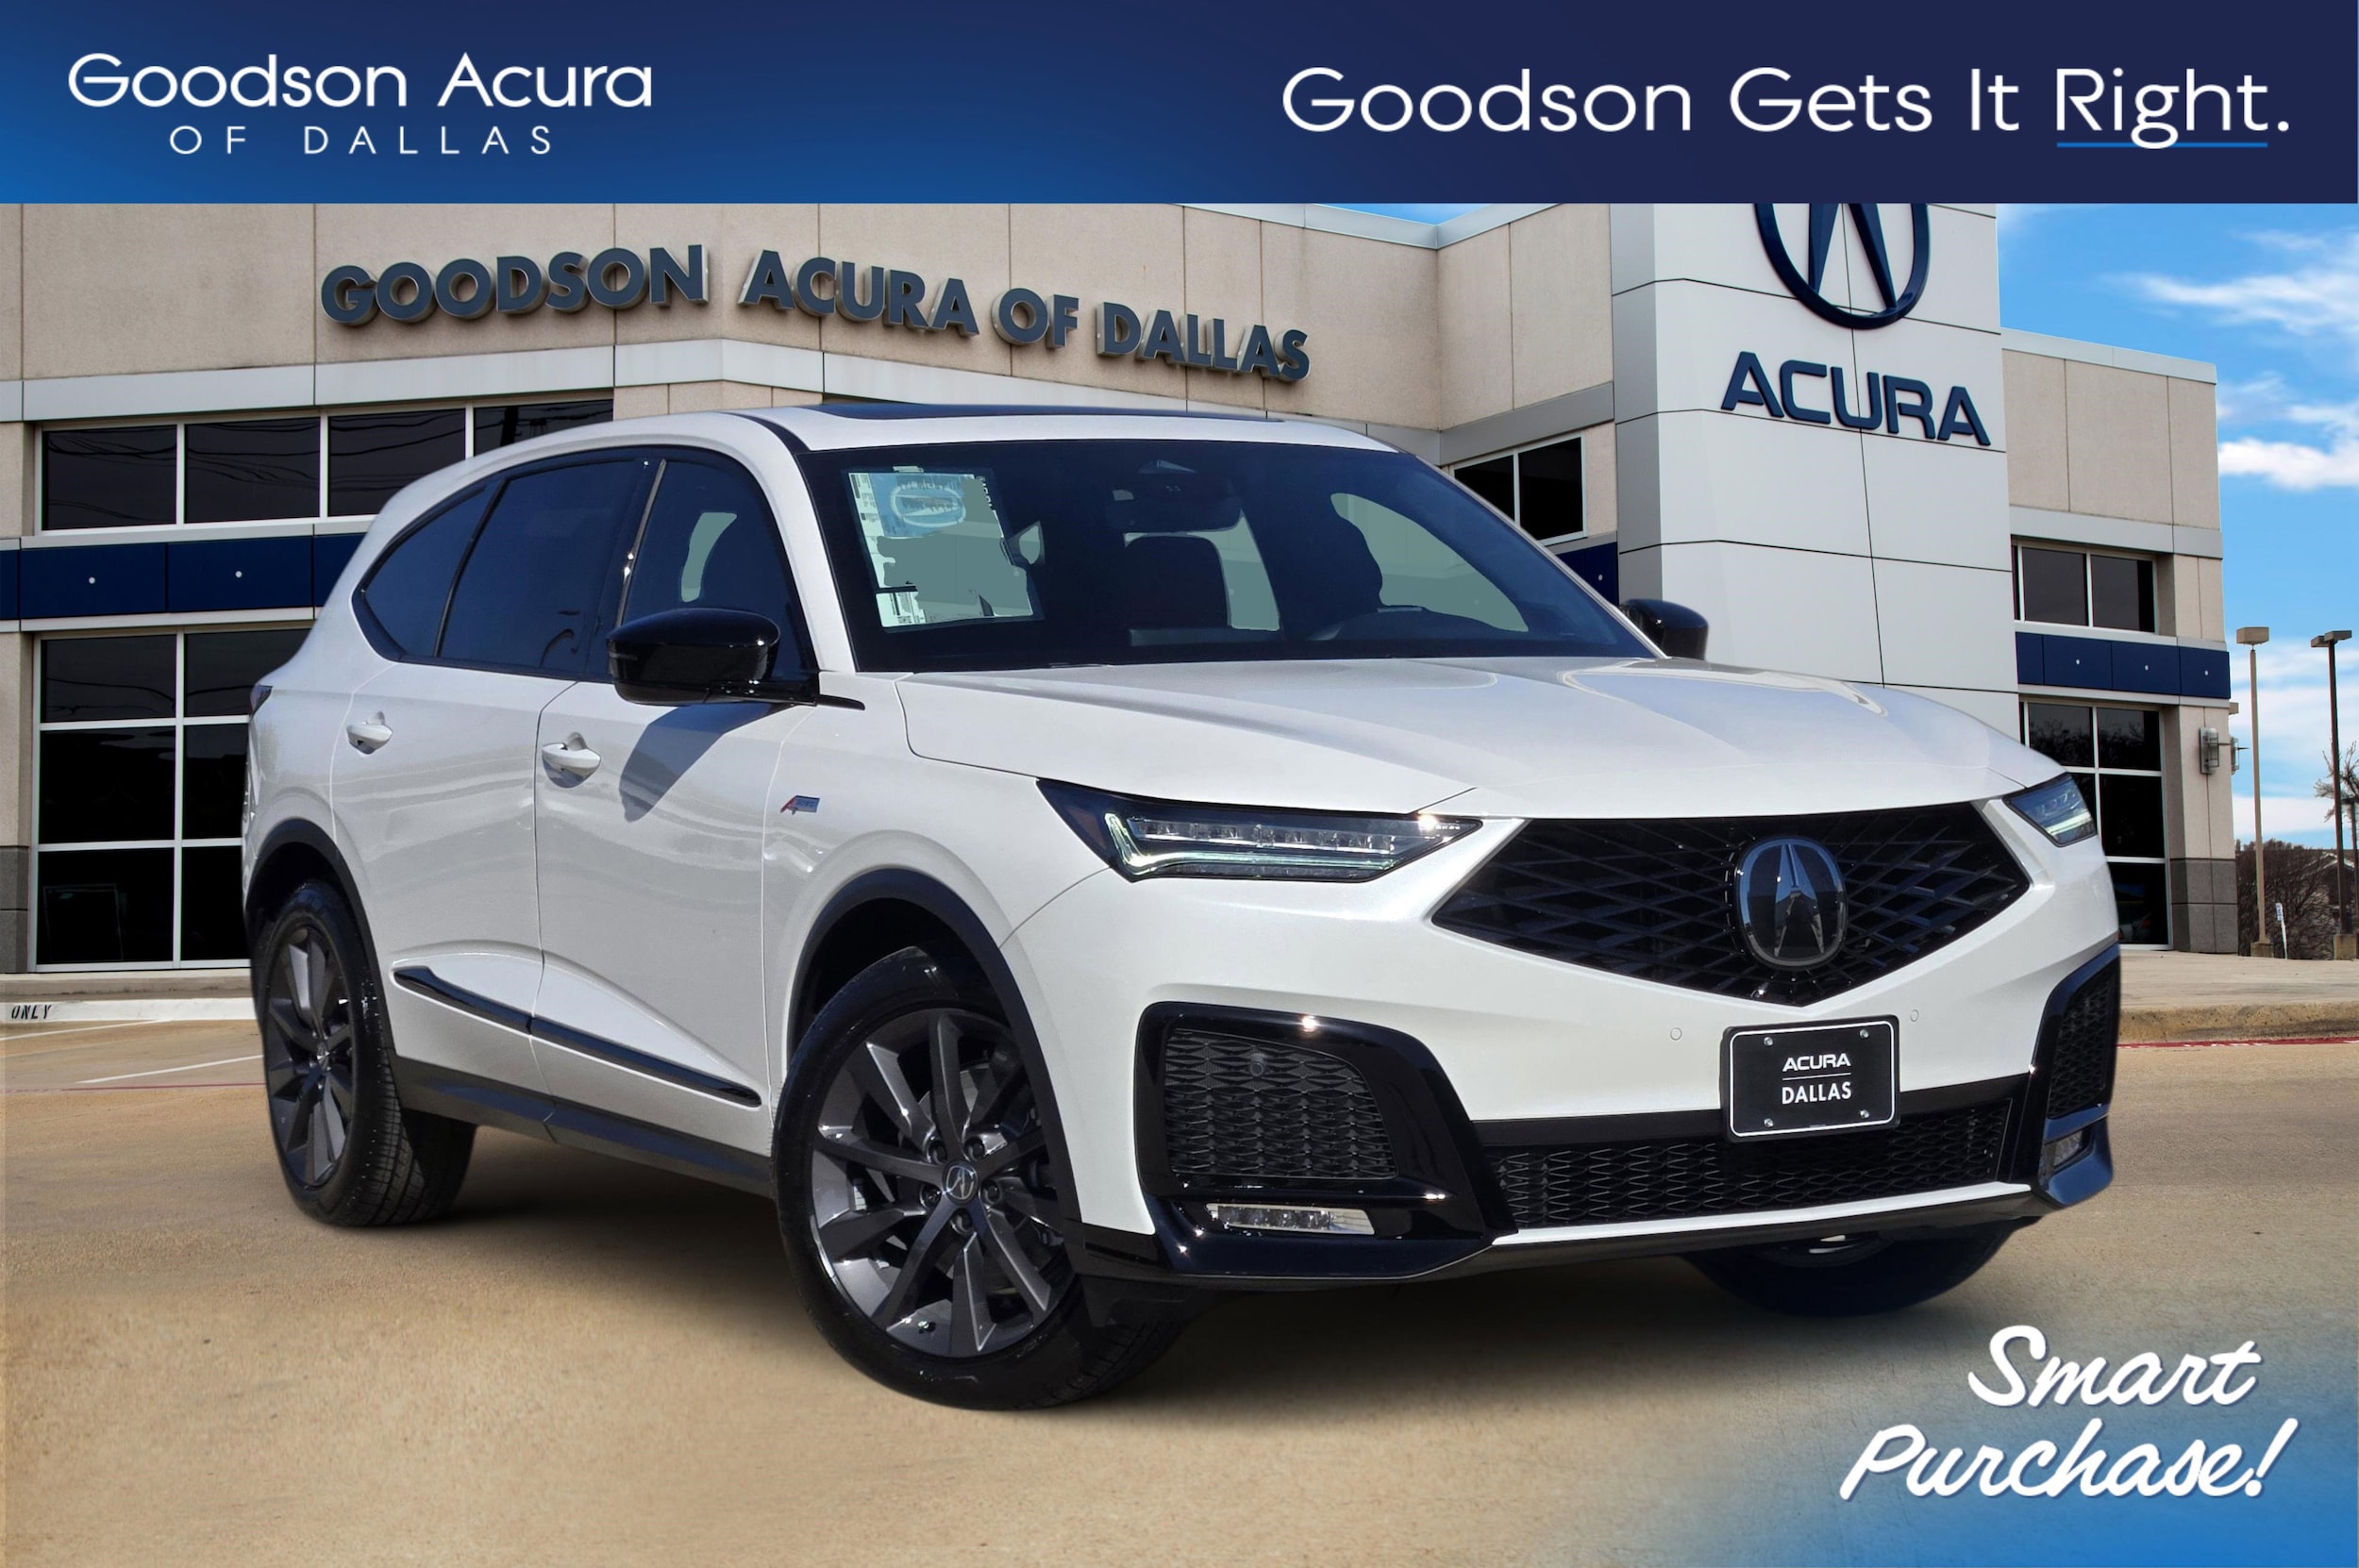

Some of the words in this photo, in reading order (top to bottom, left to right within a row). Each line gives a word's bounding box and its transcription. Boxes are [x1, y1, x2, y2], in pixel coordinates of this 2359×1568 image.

[321, 243, 710, 327] GOODSON
[738, 249, 979, 338] ACURA
[992, 287, 1080, 349] OF
[1096, 301, 1311, 383] DALLAS
[1720, 350, 1992, 447] ACURA
[11, 1004, 52, 1020] ONLY
[1782, 1052, 1851, 1073] ACURA
[1781, 1080, 1852, 1105] DALLAS
